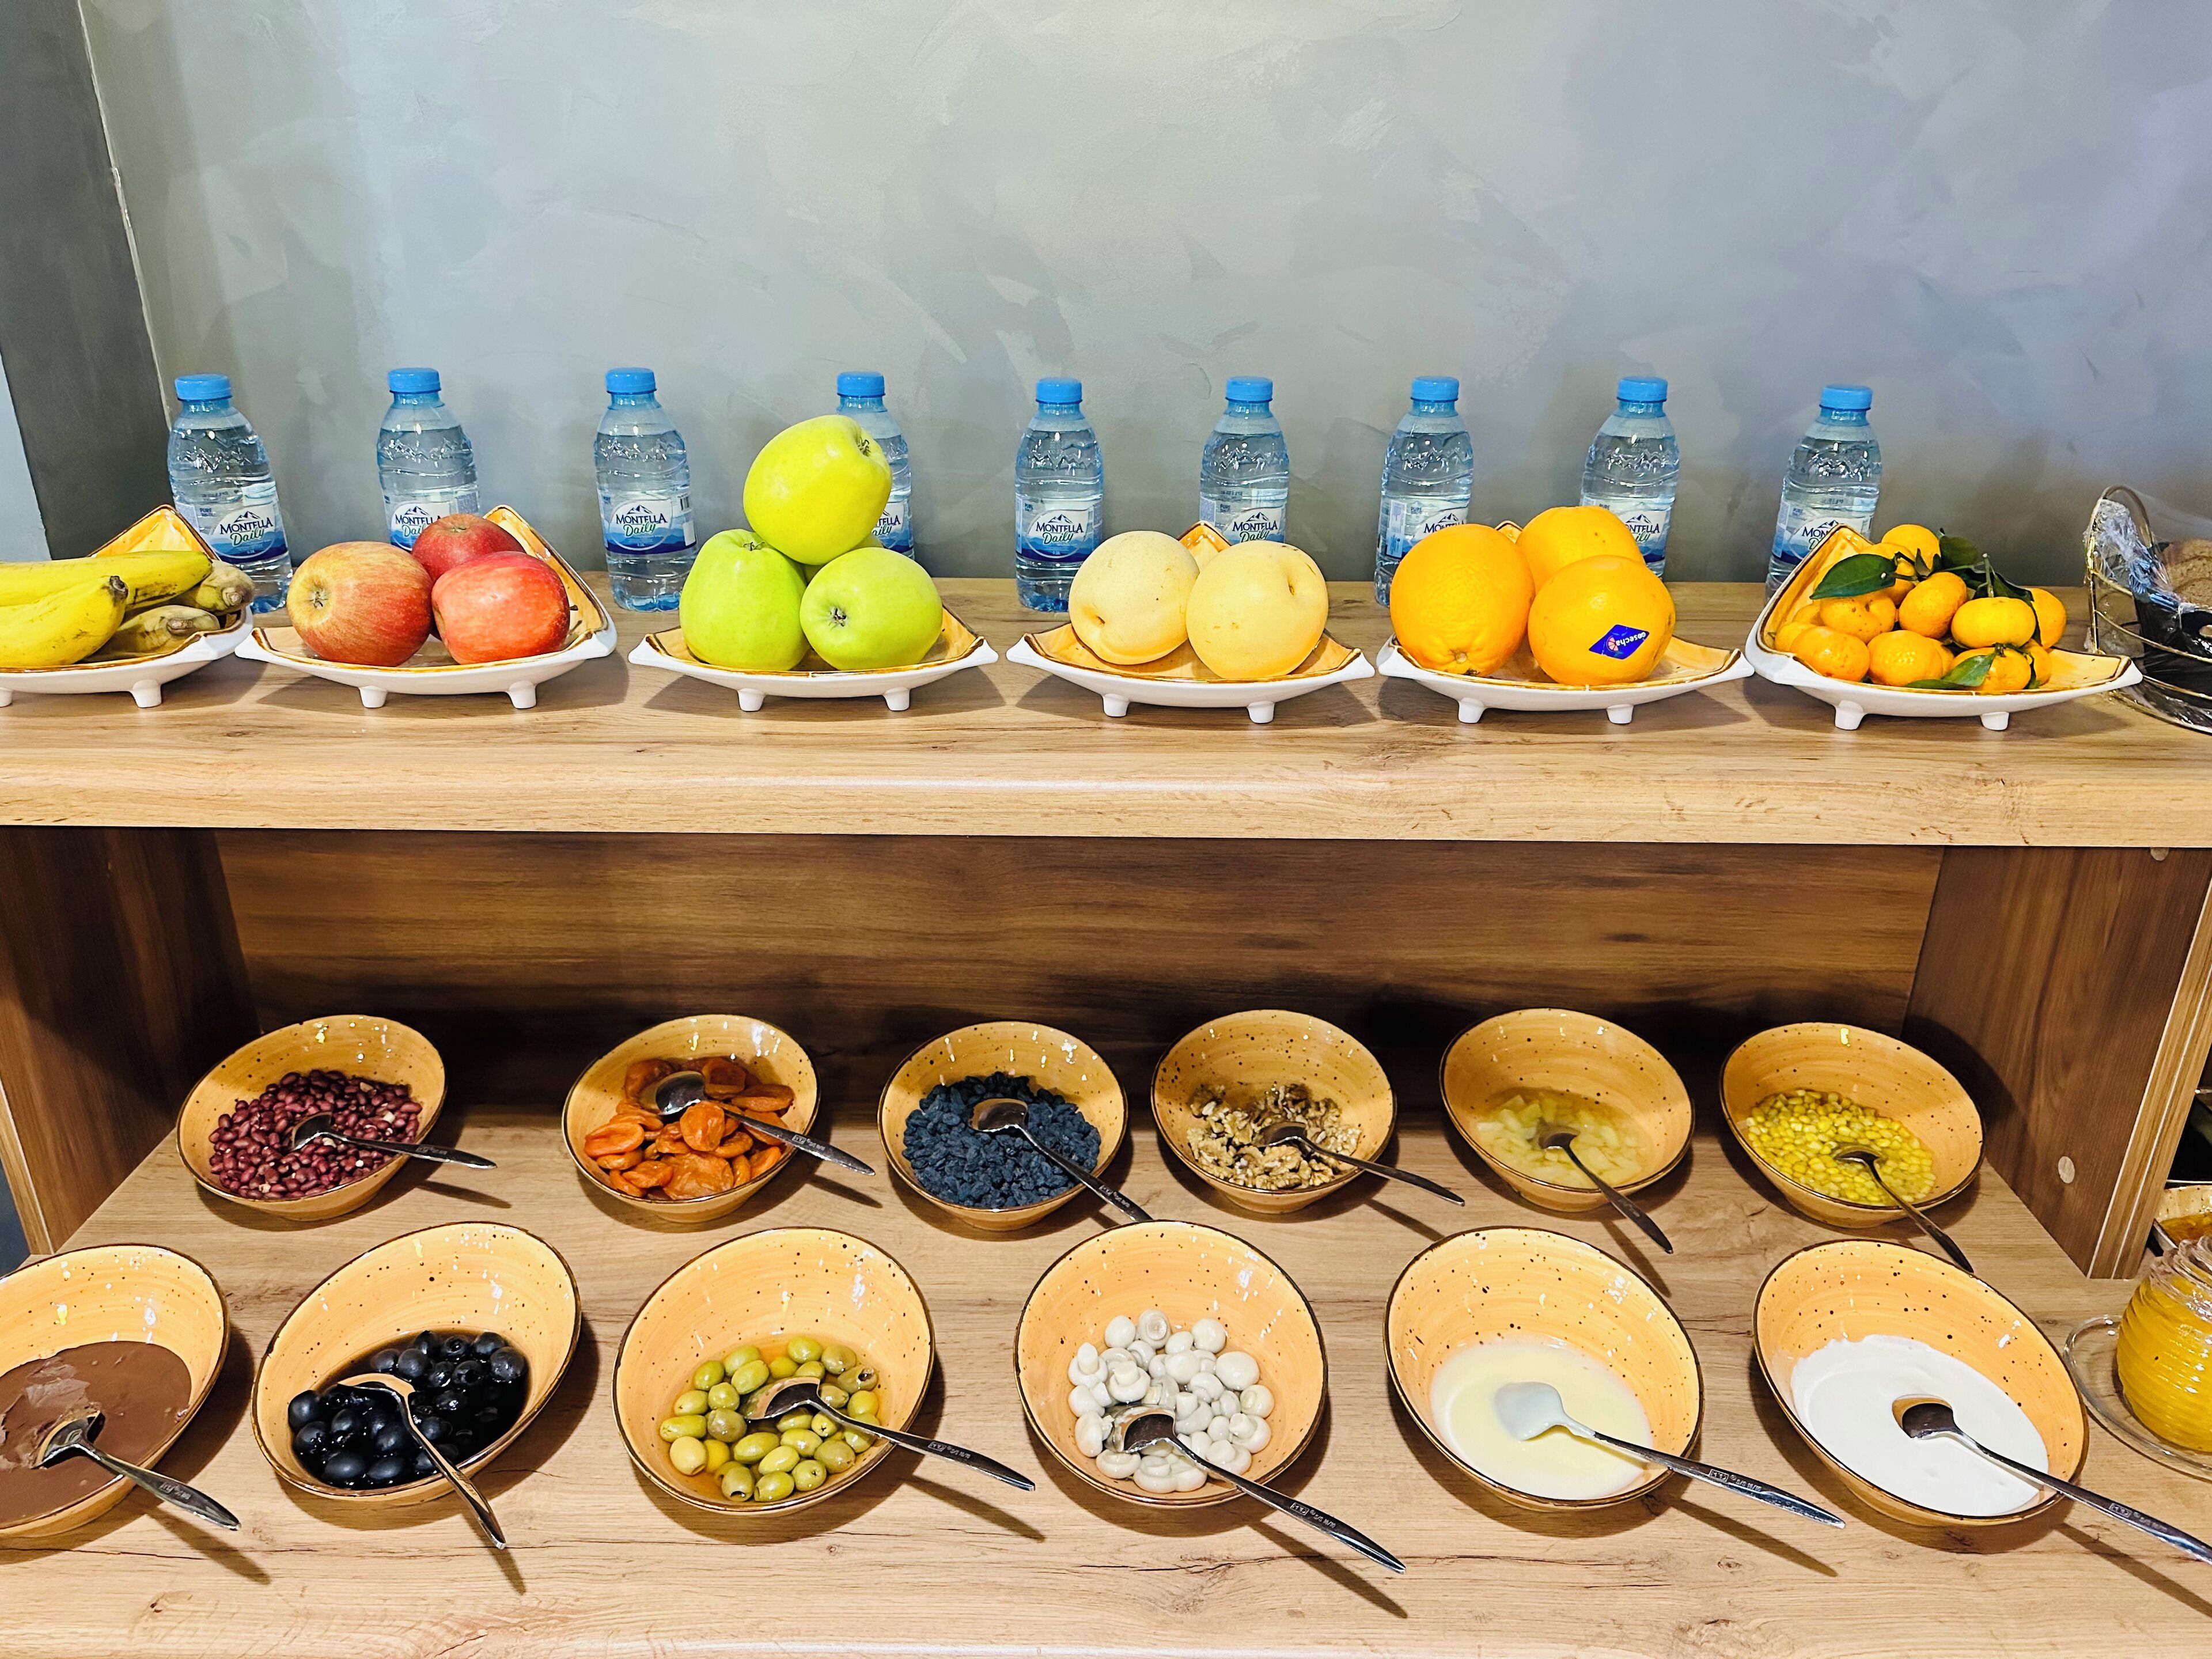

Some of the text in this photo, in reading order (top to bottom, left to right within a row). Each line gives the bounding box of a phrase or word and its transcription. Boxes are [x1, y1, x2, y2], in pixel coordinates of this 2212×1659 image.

[616, 513, 668, 524] MONTELLA
[220, 517, 273, 535] MONTELLA
[623, 522, 656, 536] Daily
[1036, 522, 1084, 533] MONTELLA
[1232, 520, 1278, 532] MONTELLA
[230, 527, 265, 546] Daily
[1043, 531, 1074, 544] Daily
[1240, 528, 1270, 543] Daily
[1615, 631, 1646, 646] cosecha
